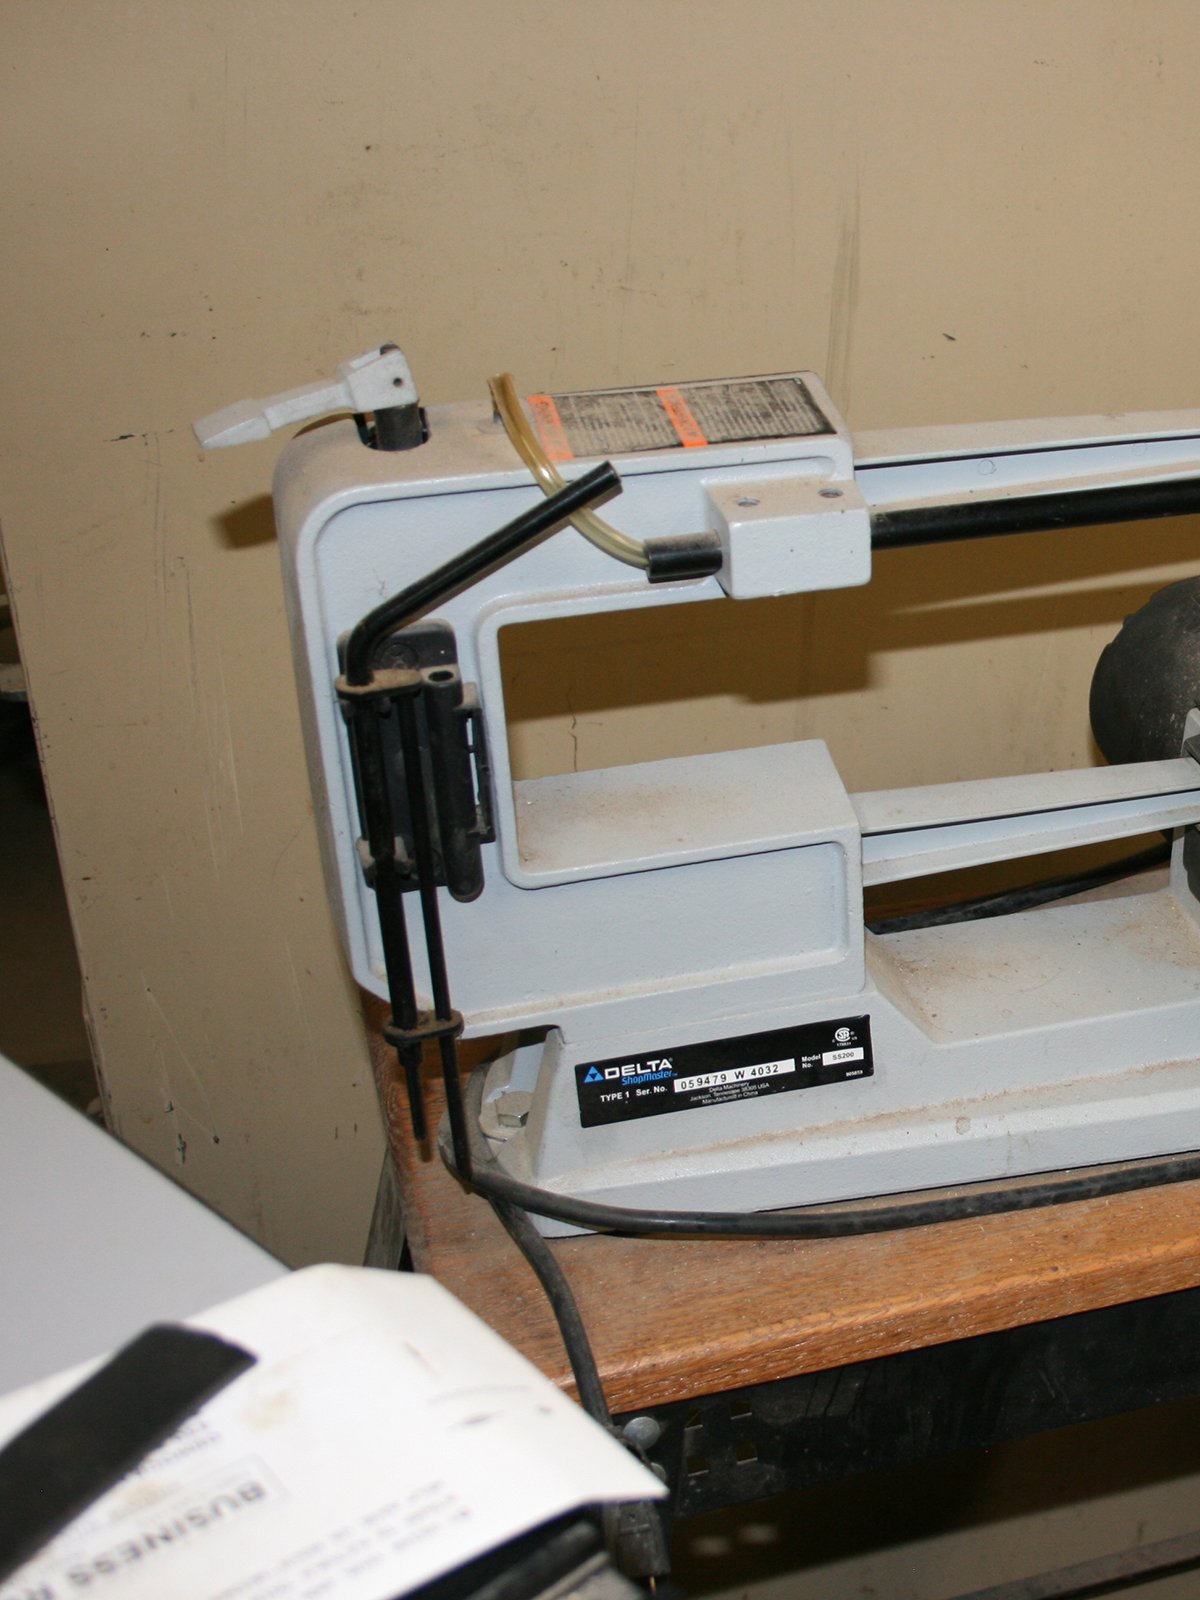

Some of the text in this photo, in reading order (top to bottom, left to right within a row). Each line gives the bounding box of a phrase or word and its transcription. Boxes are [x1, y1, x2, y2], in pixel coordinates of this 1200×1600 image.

[801, 1054, 821, 1062] Model
[832, 1052, 855, 1060] SS200
[604, 1058, 672, 1079] DELTA
[680, 1064, 778, 1089] 059479 W 4032
[758, 1082, 770, 1090] USA
[600, 1092, 622, 1102] TYPE
[636, 1088, 652, 1096] Ser.
[68, 1480, 266, 1588] BUSINESS
